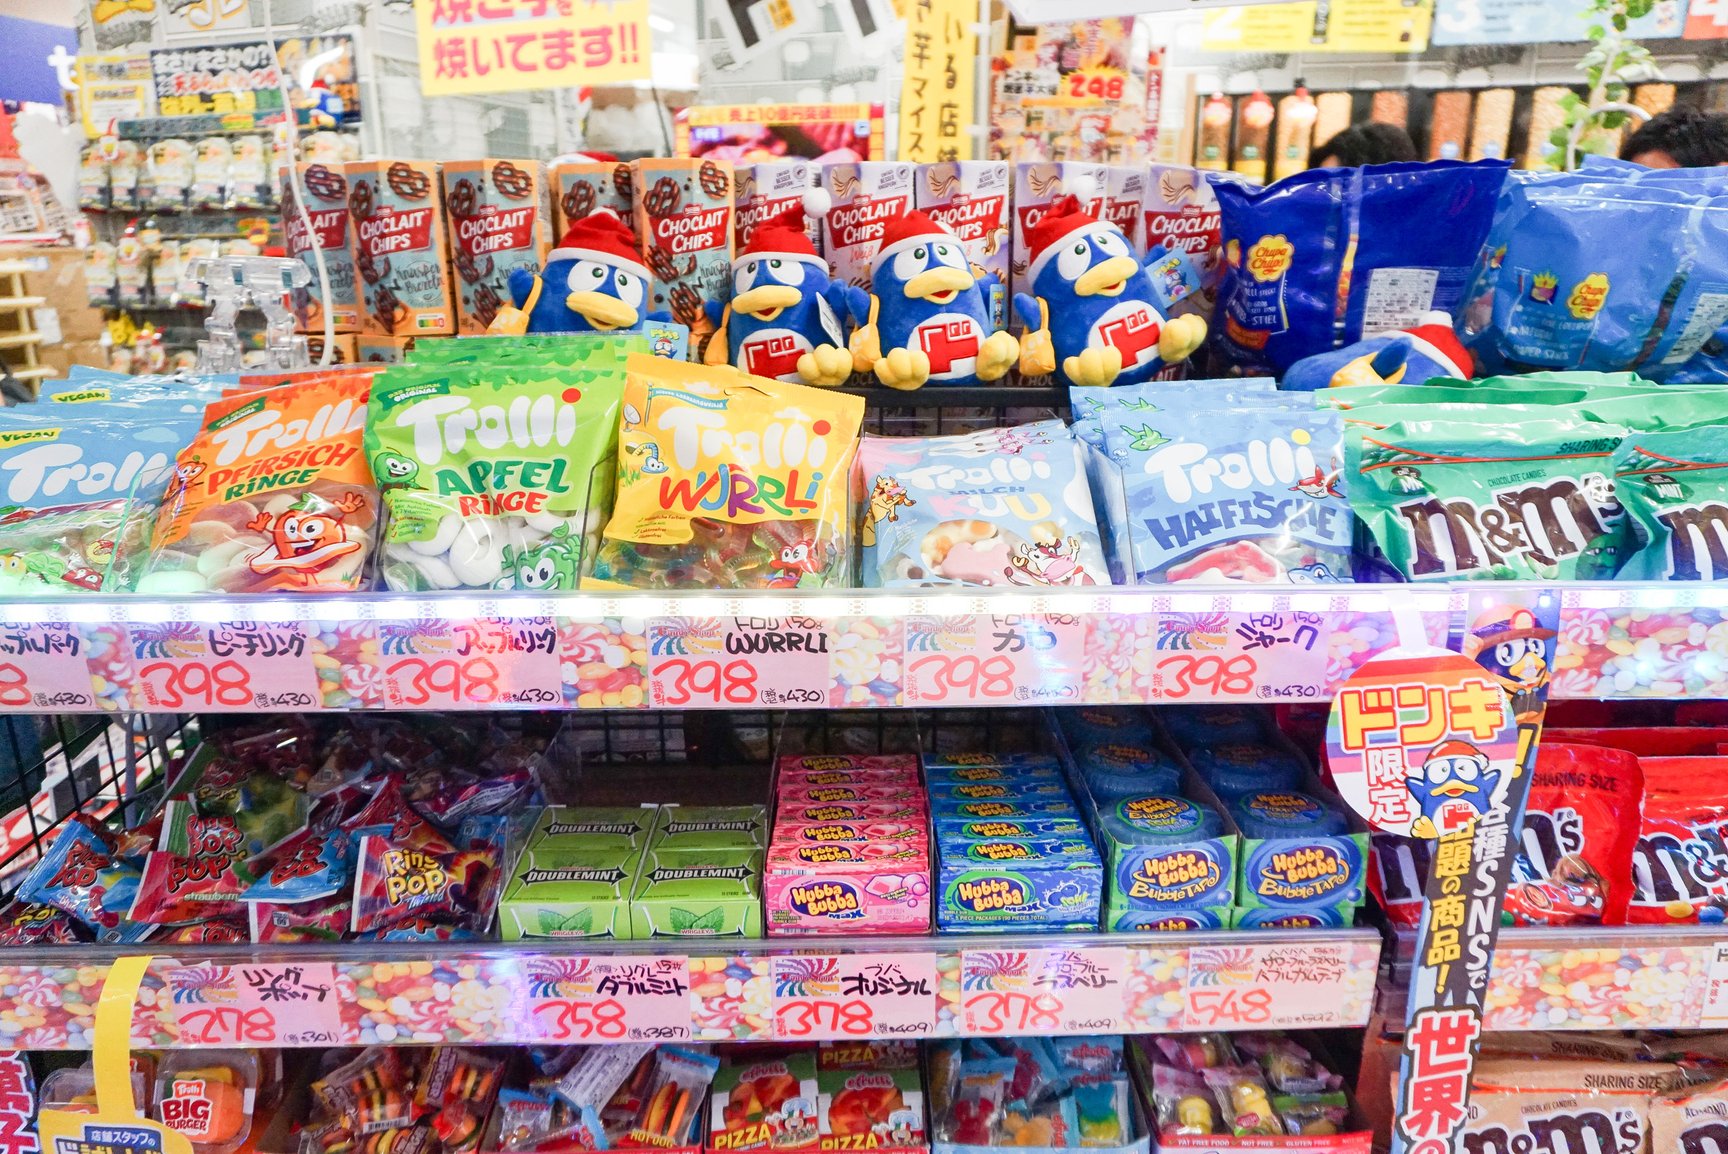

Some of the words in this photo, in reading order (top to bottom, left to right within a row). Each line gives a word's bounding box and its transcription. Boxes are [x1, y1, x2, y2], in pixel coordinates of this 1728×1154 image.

[1070, 74, 1124, 99] 298
[360, 211, 423, 240] CHOCLAIT
[460, 210, 527, 240] CHOCLAIT
[658, 210, 724, 239] CHOCLAIT
[832, 199, 899, 230] CHOCLAIT
[370, 233, 411, 256] CHIPS
[471, 232, 513, 255] CHIPS
[671, 232, 713, 254] CHIPS
[843, 222, 885, 245] CHIPS
[1252, 257, 1285, 269] Chups
[1254, 246, 1288, 258] Chupa
[56, 391, 106, 402] VEGAN
[395, 387, 582, 466] Trolli
[657, 406, 832, 471] Trolli
[1559, 438, 1607, 455] SHARING
[895, 452, 1050, 490] Trolli
[1144, 428, 1316, 504] Trolli
[434, 458, 570, 499] APFEL
[928, 492, 1052, 522] KUU
[1143, 490, 1337, 551] HAIFISCHE
[1250, 613, 1284, 630] トロリ
[725, 631, 829, 654] WURRLI
[140, 661, 253, 708] 398
[386, 657, 499, 705] 398
[652, 658, 758, 705] 398
[909, 654, 1015, 701] 398
[1156, 654, 1257, 698] 398
[1341, 680, 1505, 750] ドンキ
[1365, 746, 1410, 824] 限定
[1531, 772, 1585, 789] SHARING
[1590, 774, 1617, 792] SIZE
[549, 823, 635, 834] DOUBLEMINT
[668, 821, 752, 832] DOUBLEMINT
[804, 825, 843, 836] Hubba
[817, 831, 854, 841] Bubba
[970, 822, 1008, 834] Hubba
[984, 827, 1021, 837] Bubba
[800, 845, 839, 857] Hubba
[812, 851, 851, 862] Bubba
[975, 842, 1014, 855] Hubba
[989, 848, 1027, 860] Bubba
[1144, 853, 1196, 877] Hubba
[1272, 848, 1324, 873] Hubba
[1287, 856, 1337, 883] Bubba
[526, 869, 619, 882] DOUBLEMINT
[653, 866, 745, 880] DOUBLEMINT
[1158, 860, 1209, 887] Bubba
[792, 883, 843, 906] Hubba
[958, 879, 1010, 902] Hubba
[973, 889, 1023, 911] Bubba
[808, 892, 857, 916] Bubba
[596, 975, 688, 997] ダブルミント
[841, 972, 931, 996] オリジナル
[776, 1000, 873, 1035] 378
[964, 992, 1064, 1033] 378
[1189, 988, 1272, 1025] 548
[178, 1007, 276, 1043] 278
[532, 998, 626, 1039] 358
[823, 1046, 874, 1065] PIZZA
[177, 1083, 201, 1096] Trolli
[1584, 1075, 1635, 1089] SHARING
[1637, 1075, 1663, 1090] SIZE
[163, 1099, 210, 1119] BIG
[91, 1130, 156, 1146] 店舗スタッフの
[652, 1133, 673, 1147] DOG
[714, 1124, 771, 1150] PIZZA
[822, 1132, 878, 1150] PIZZA
